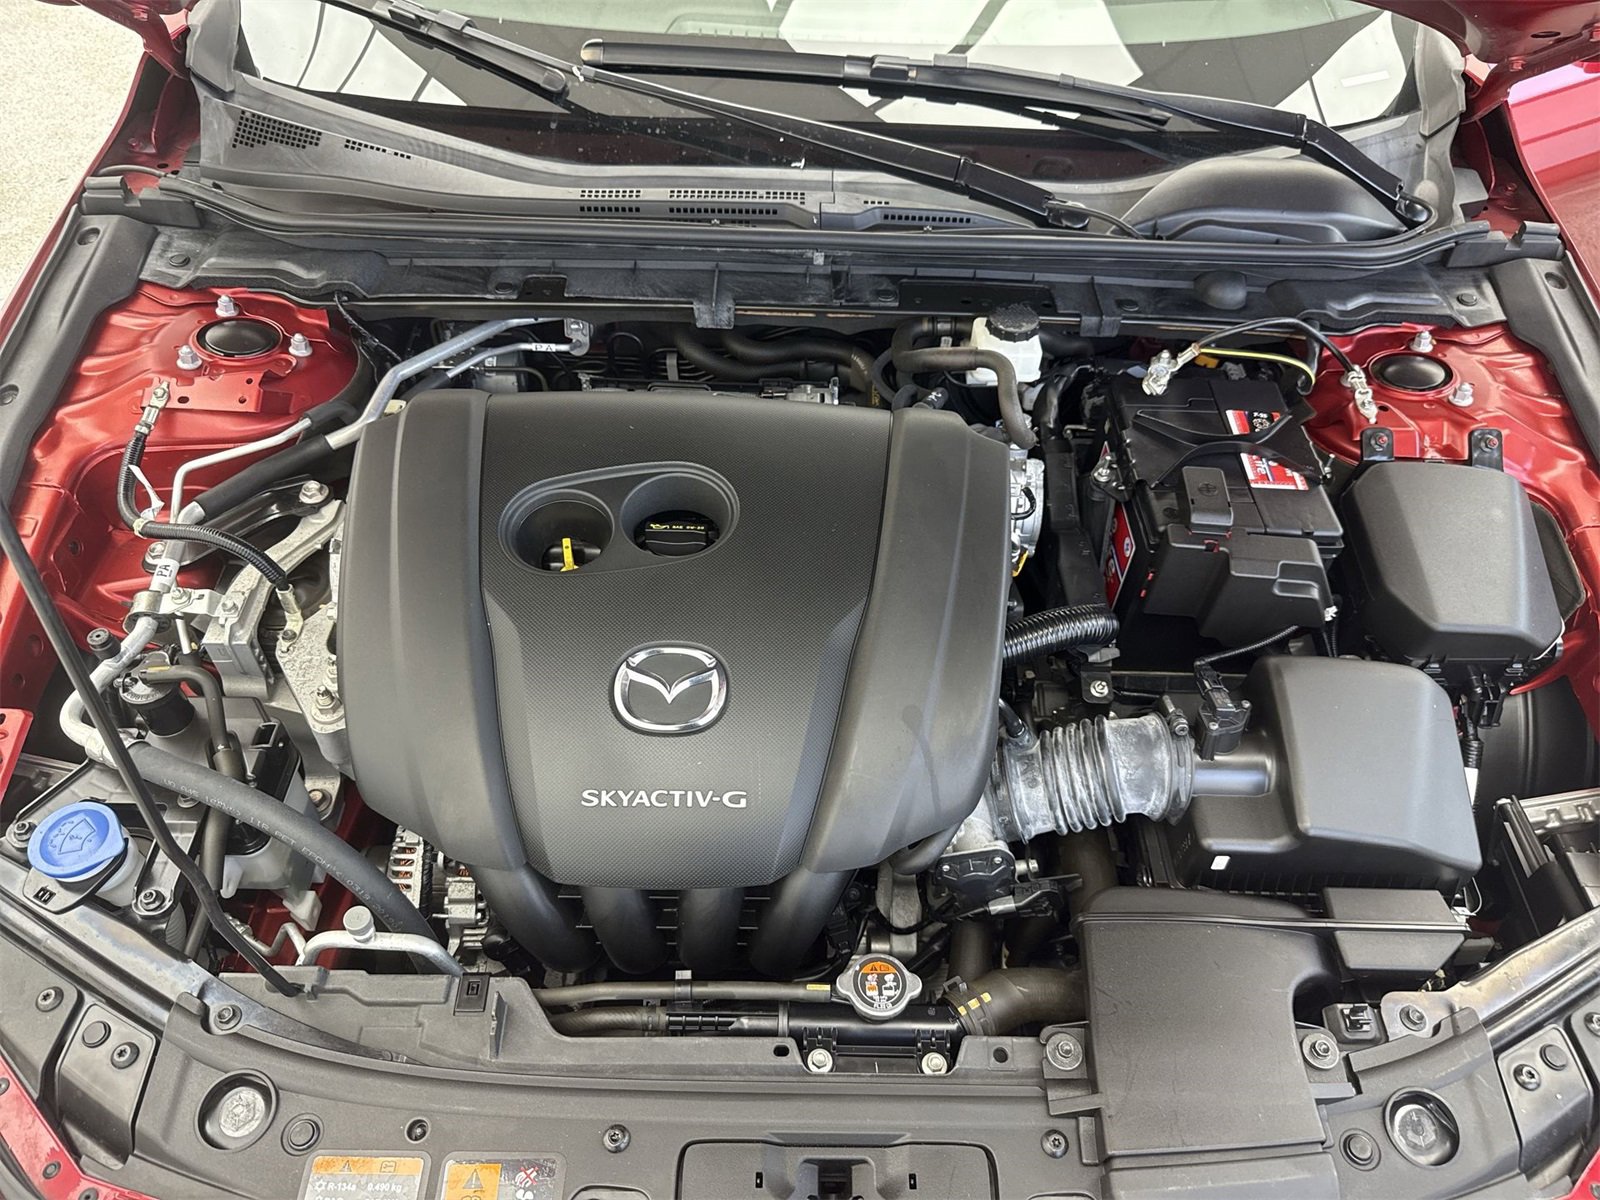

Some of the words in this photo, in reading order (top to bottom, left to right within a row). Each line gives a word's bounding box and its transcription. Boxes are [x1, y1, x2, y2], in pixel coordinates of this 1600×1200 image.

[157, 564, 171, 577] PA
[581, 789, 748, 808] SKYACTIV-G
[327, 1181, 358, 1192] R-134a
[391, 1182, 403, 1194] kg
